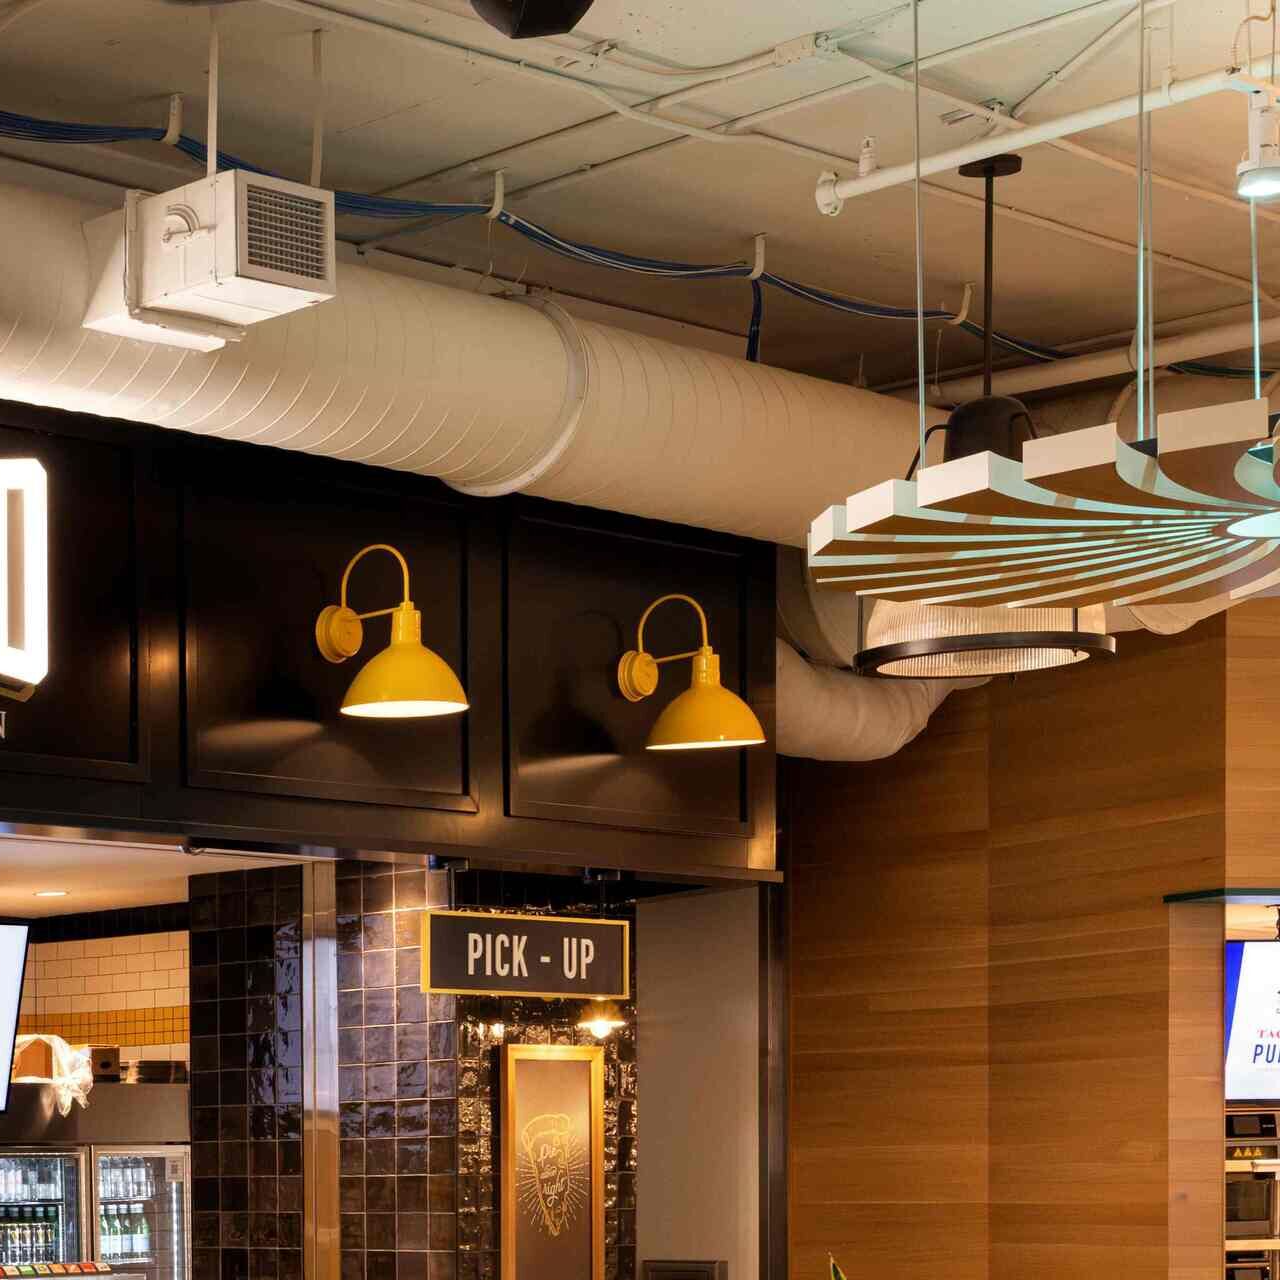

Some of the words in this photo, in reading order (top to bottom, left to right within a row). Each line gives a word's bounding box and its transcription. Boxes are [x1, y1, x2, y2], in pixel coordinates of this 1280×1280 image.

[467, 932, 529, 977] PICK
[563, 936, 595, 980] UP
[1252, 1043, 1280, 1065] PU
